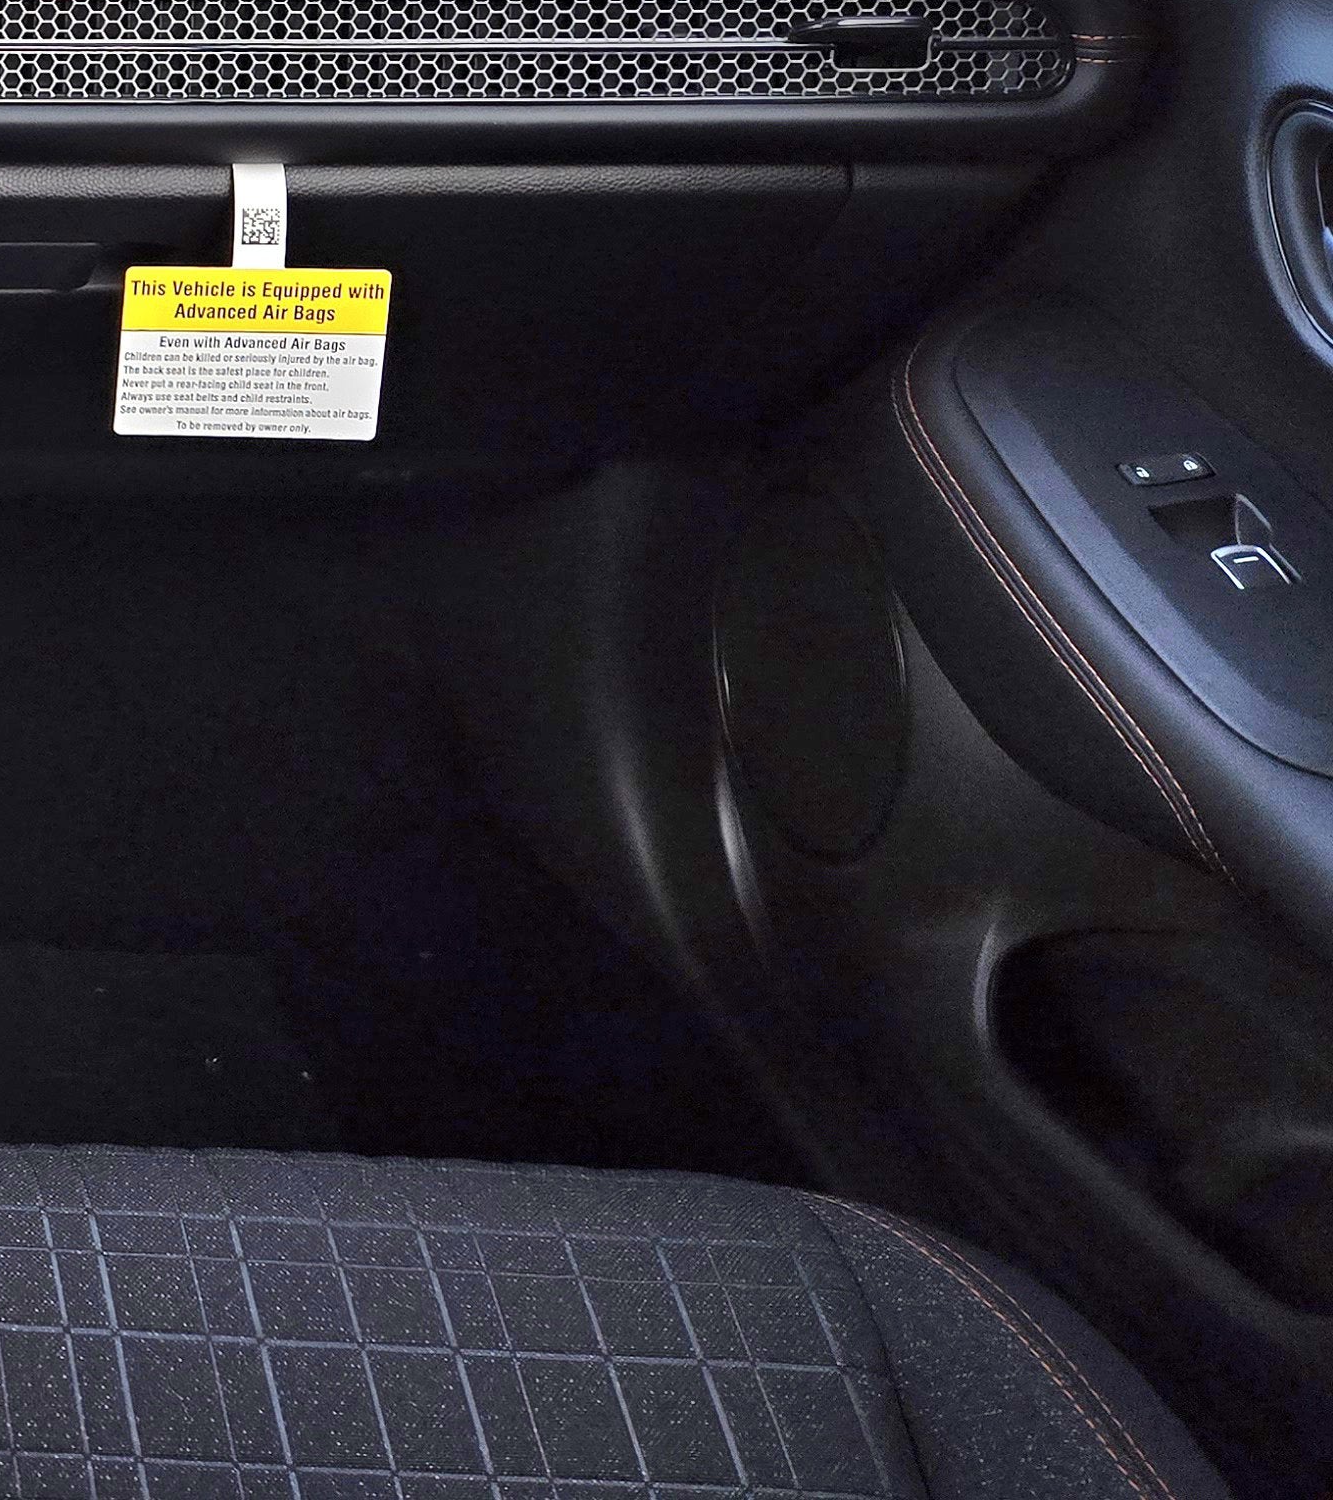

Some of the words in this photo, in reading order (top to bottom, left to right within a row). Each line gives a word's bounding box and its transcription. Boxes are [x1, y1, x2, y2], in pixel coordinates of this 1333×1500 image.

[131, 280, 165, 296] This
[173, 281, 235, 298] Vehicle
[242, 282, 255, 298] is
[262, 282, 342, 300] Equipped
[348, 284, 385, 300] with
[175, 304, 256, 319] Advanced
[263, 304, 287, 320] Air
[294, 305, 335, 324] Bags
[159, 336, 189, 348] Even
[194, 337, 220, 348] with
[224, 337, 287, 350] Advanced
[291, 338, 310, 350] Air
[314, 339, 345, 352] Bags
[124, 352, 162, 362] Children
[164, 354, 180, 362] can
[183, 353, 194, 362] be
[196, 353, 221, 362] killed
[235, 354, 276, 365] seriously
[278, 355, 311, 366] injured
[313, 355, 324, 365] by
[326, 355, 340, 364] the
[343, 356, 355, 365] air
[358, 357, 378, 367] bag.
[124, 366, 141, 375] The
[143, 366, 165, 375] back
[166, 366, 186, 375] seat
[188, 367, 196, 375] is
[199, 367, 213, 376] the
[215, 367, 243, 376] safest
[245, 368, 271, 378] place
[273, 368, 287, 376] for
[289, 368, 329, 378] children.
[122, 379, 149, 388] Never
[151, 380, 167, 390] put
[176, 380, 226, 390] rear-facing
[228, 380, 251, 389] child
[253, 381, 273, 390] seat
[275, 381, 285, 390] in
[287, 381, 301, 390] the
[304, 382, 329, 391] front.
[121, 392, 153, 403] Always
[155, 394, 171, 402] use
[173, 394, 194, 402] seat
[196, 394, 219, 402] belts
[221, 394, 237, 402] and
[240, 394, 263, 403] child
[265, 394, 312, 404] restraints.
[120, 405, 137, 414] See
[139, 406, 173, 415] owner's
[175, 406, 209, 415] manual
[211, 406, 223, 415] for
[251, 407, 303, 416] information
[305, 408, 331, 418] about
[333, 409, 345, 418] air
[347, 410, 372, 420] bags.
[177, 421, 187, 430] To
[189, 422, 201, 430] be
[203, 422, 243, 431] removed
[245, 422, 257, 433] by
[259, 424, 287, 432] owner
[289, 424, 311, 434] only.
